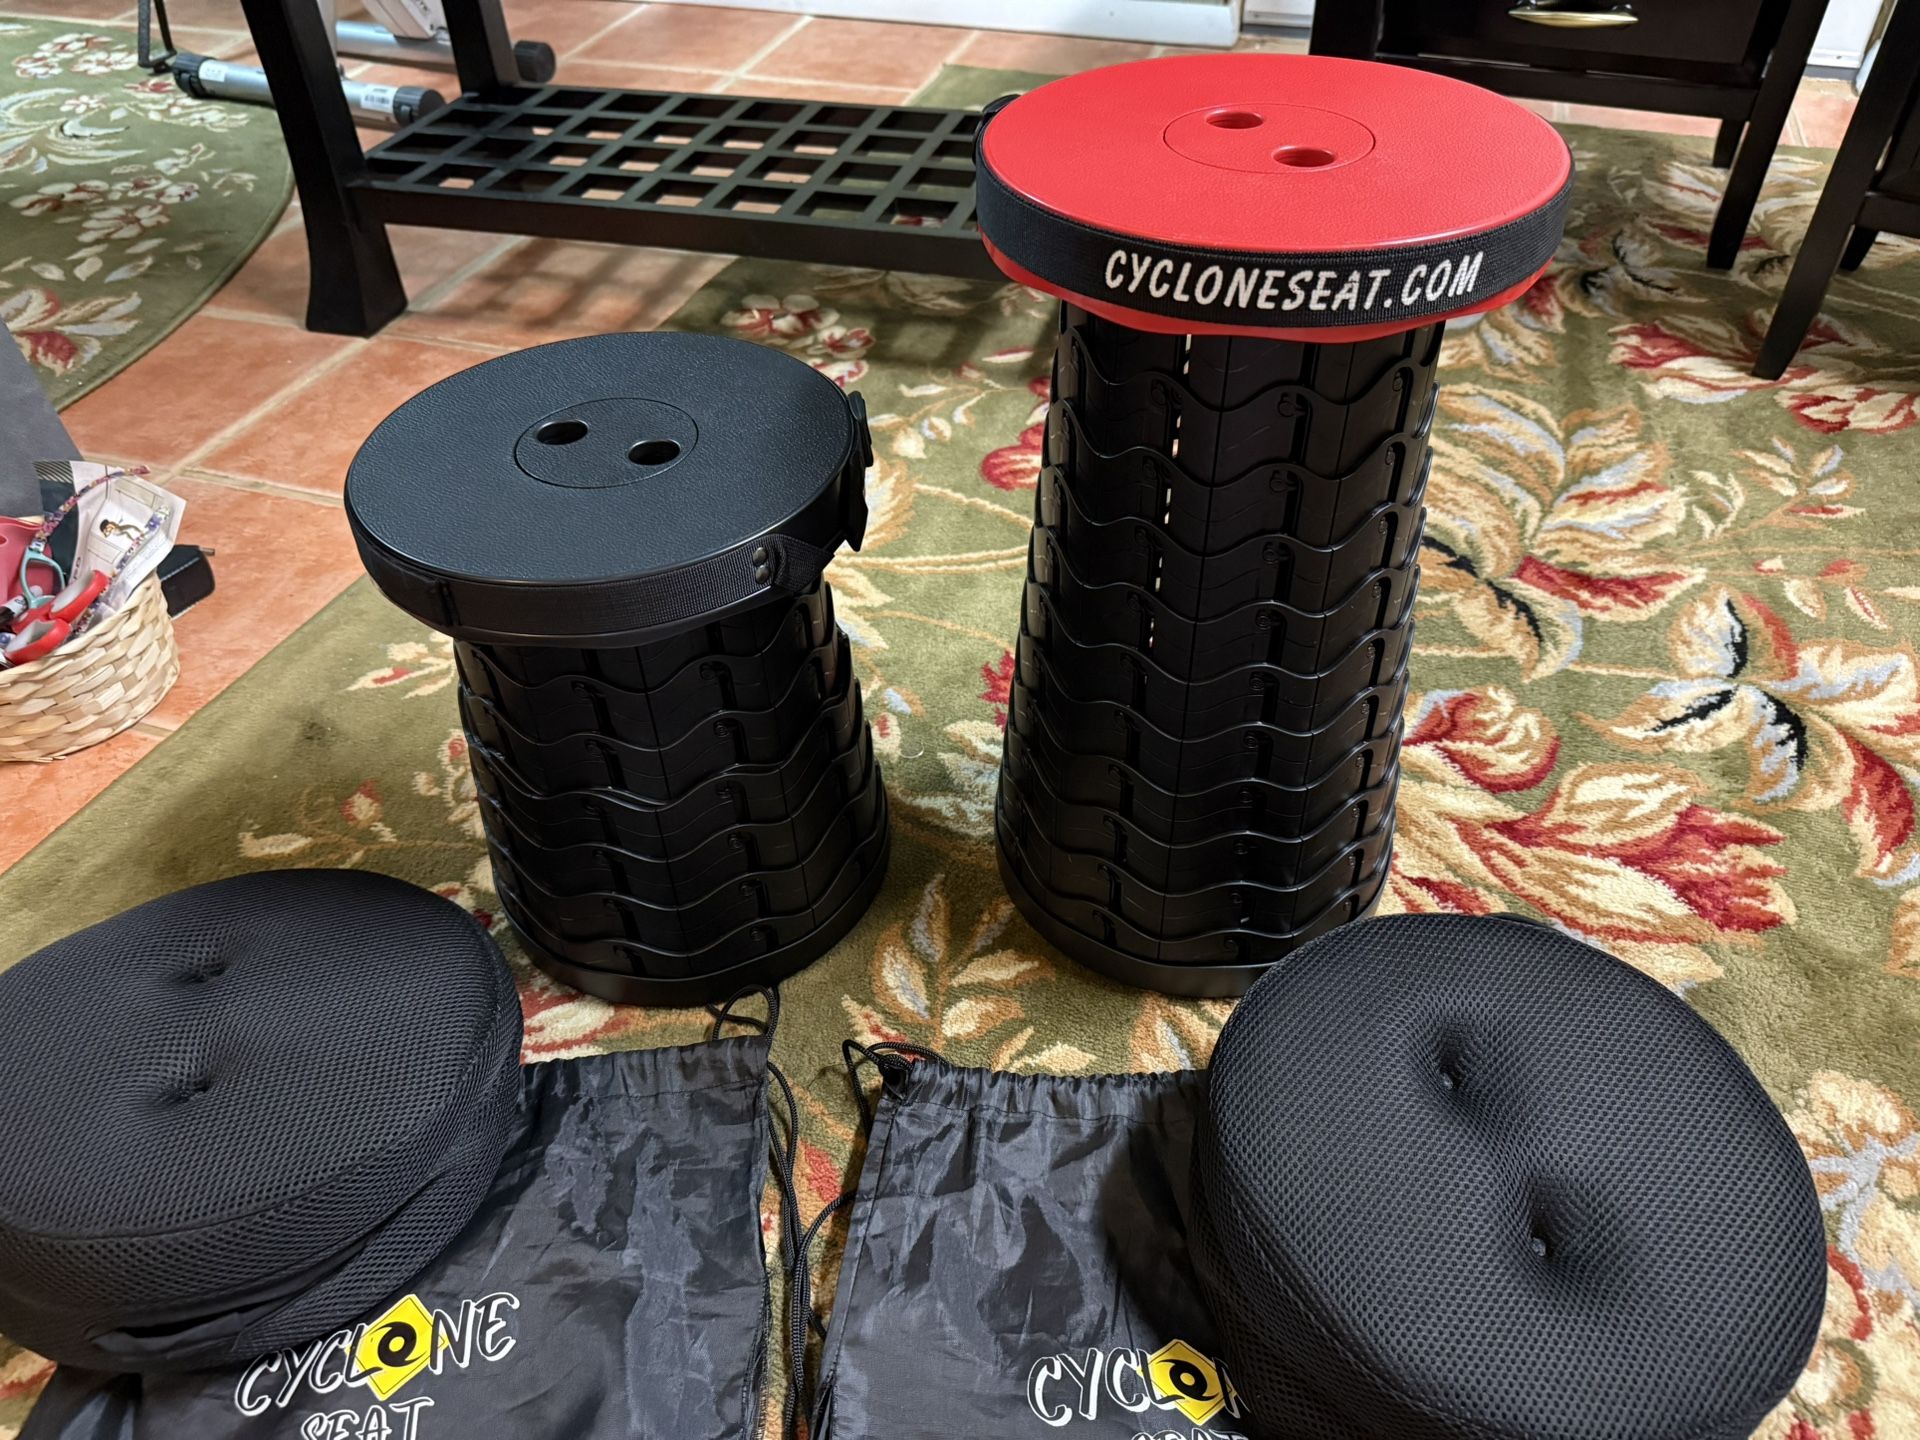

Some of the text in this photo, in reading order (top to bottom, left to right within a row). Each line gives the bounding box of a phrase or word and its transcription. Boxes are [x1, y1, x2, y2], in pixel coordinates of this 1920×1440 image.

[1105, 250, 1484, 311] CYCLONESEAT.COM
[234, 1292, 520, 1416] CYCLONE
[1027, 1346, 1251, 1427] CYCLON
